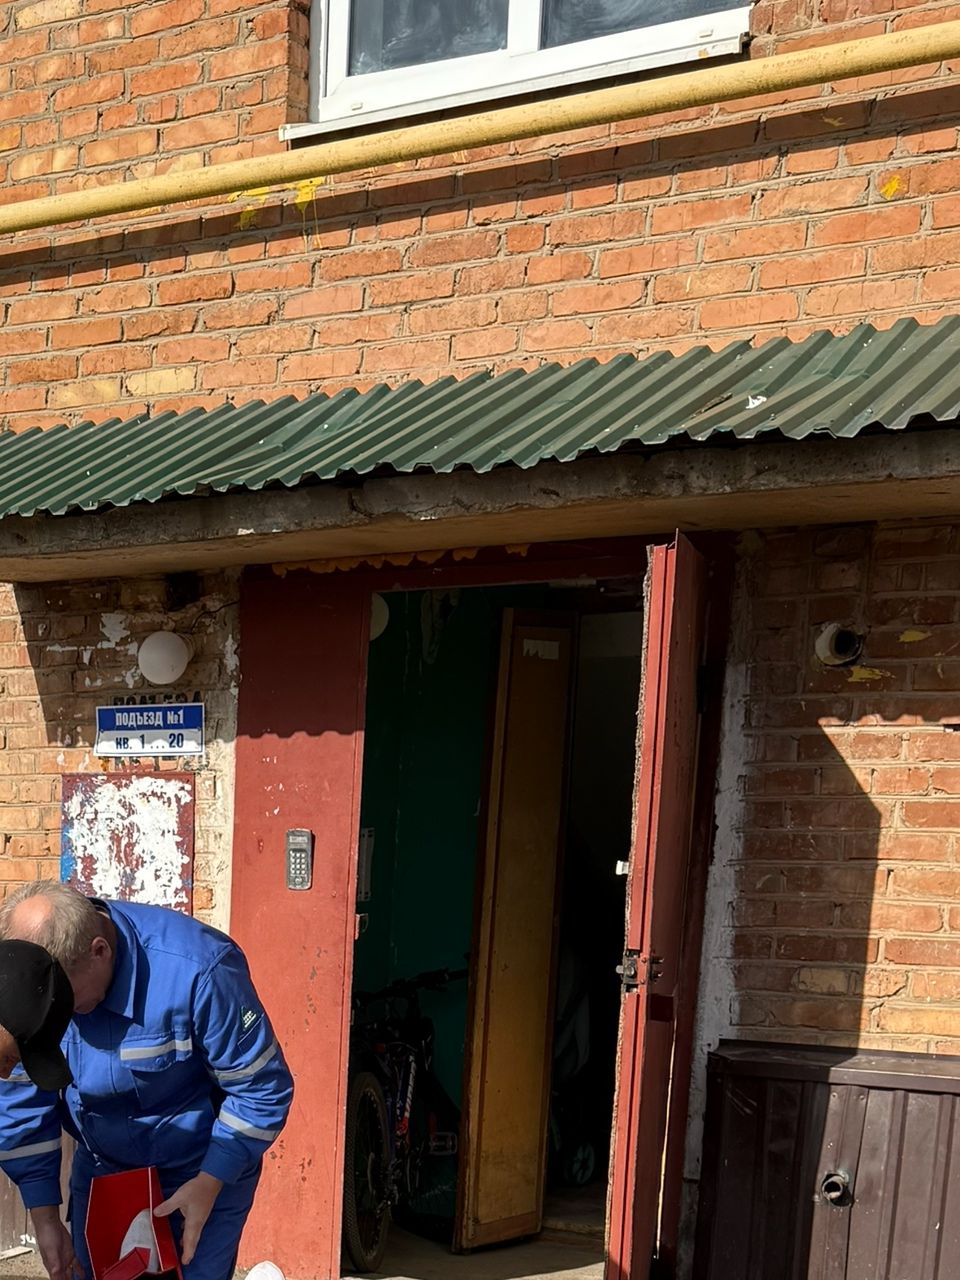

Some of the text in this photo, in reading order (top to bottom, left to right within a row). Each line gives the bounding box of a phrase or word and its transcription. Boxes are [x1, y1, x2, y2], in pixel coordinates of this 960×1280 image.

[115, 708, 184, 728] ПОДЪЕЗД №1
[139, 734, 145, 749] 1
[168, 733, 184, 748] 20
